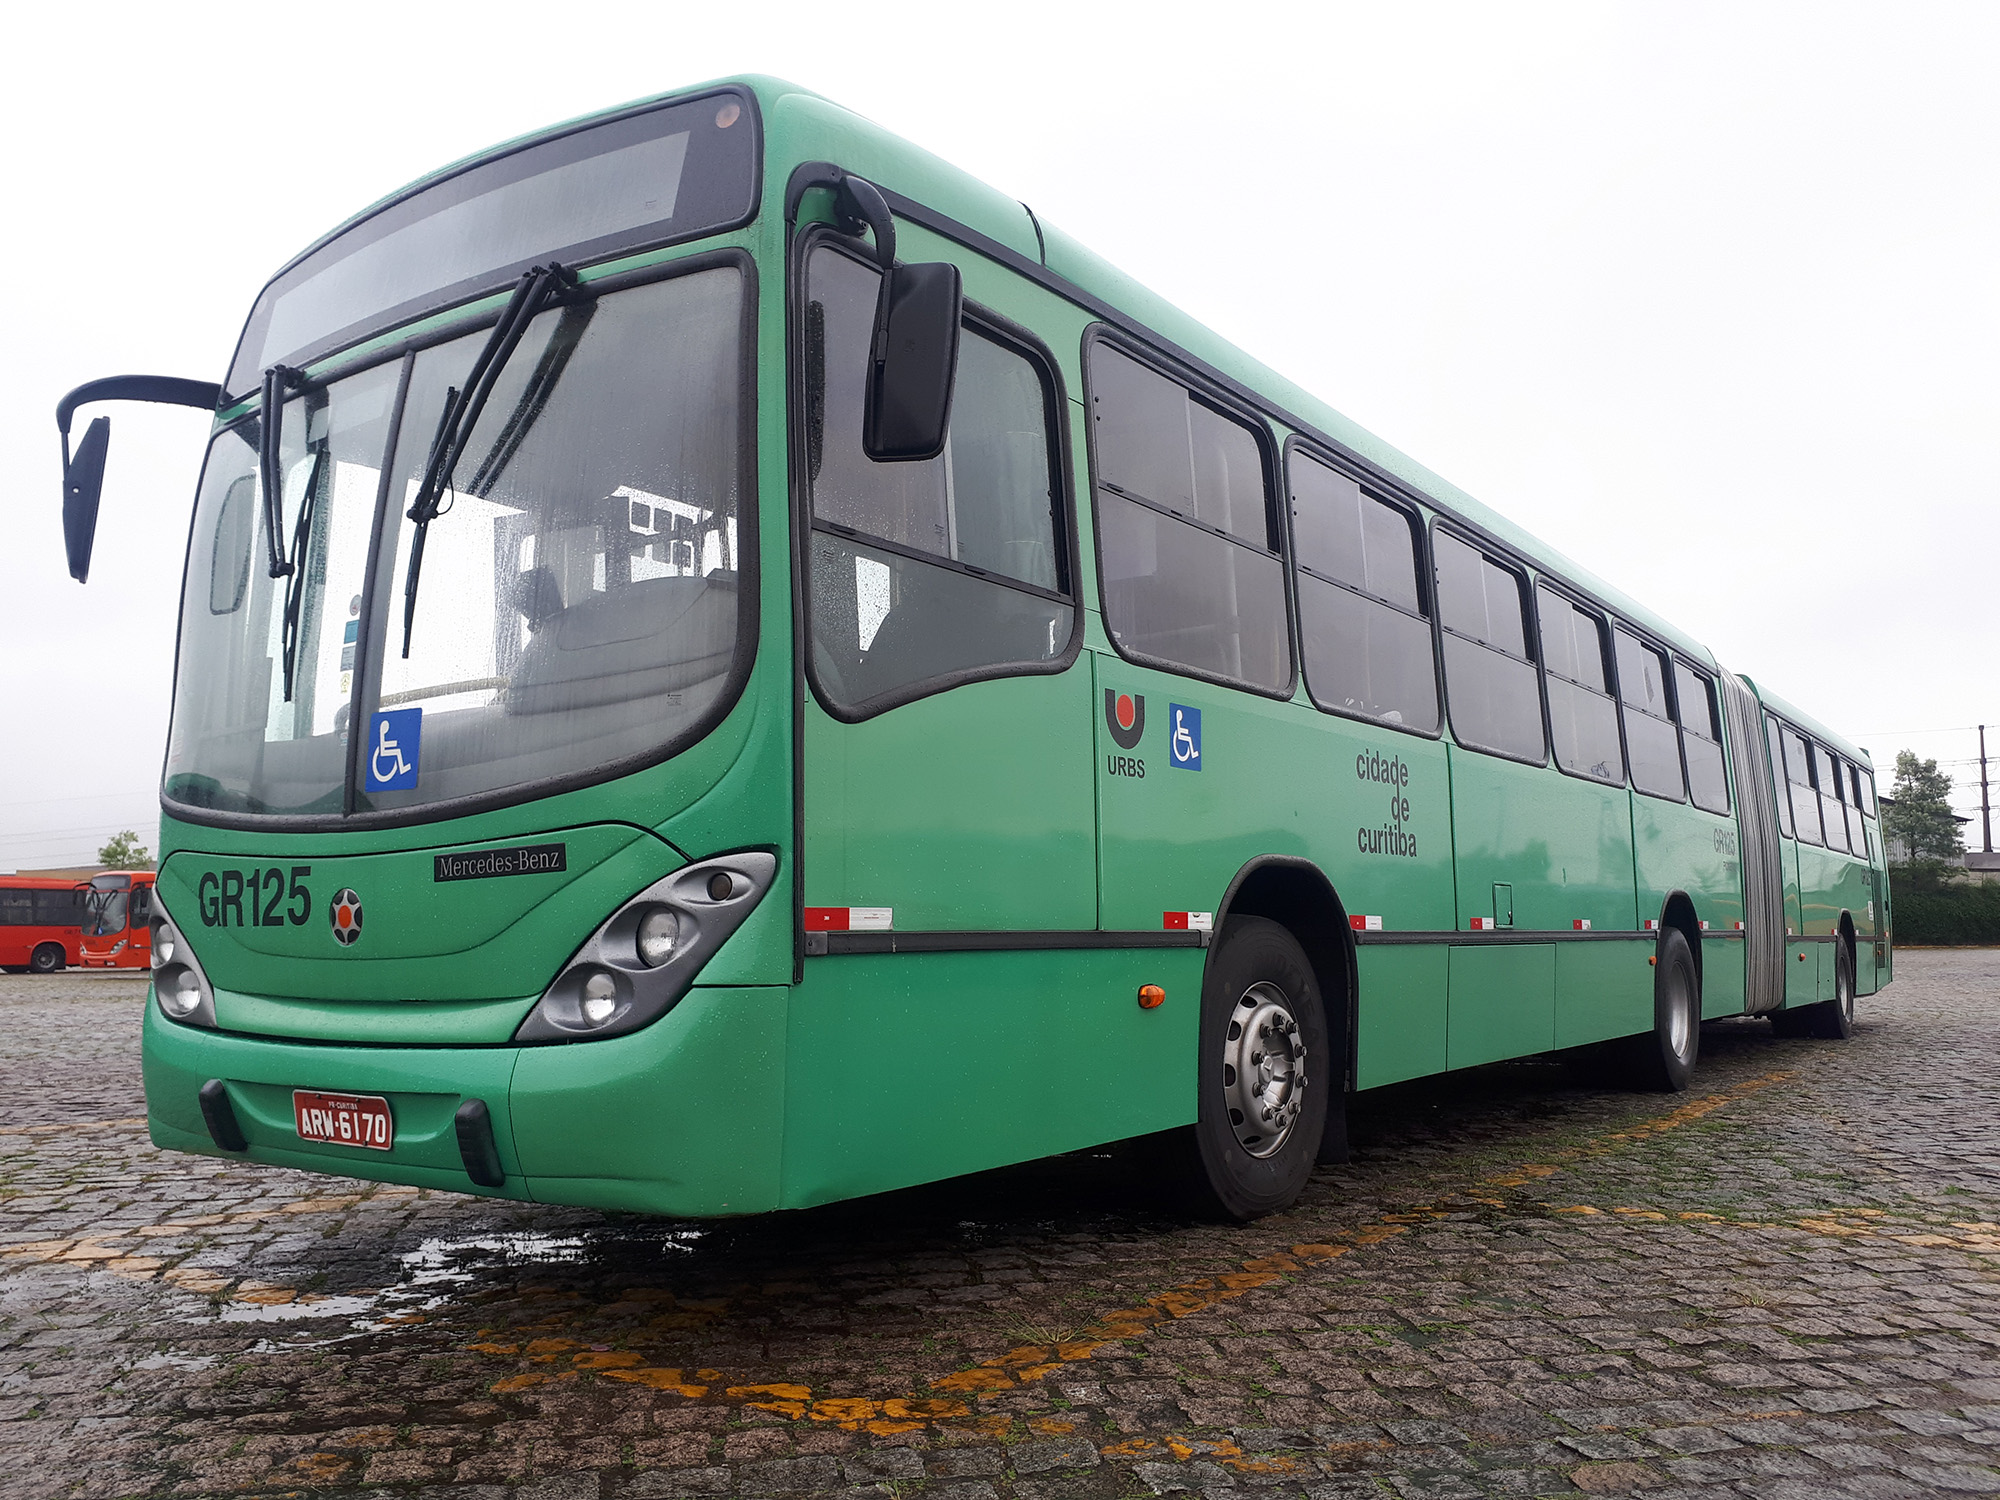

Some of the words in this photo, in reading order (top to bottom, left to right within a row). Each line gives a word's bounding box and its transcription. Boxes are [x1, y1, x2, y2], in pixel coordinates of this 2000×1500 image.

[1107, 755, 1145, 779] URBS
[1356, 748, 1408, 787] cidade
[1391, 789, 1410, 822] de
[1357, 822, 1417, 857] curitiba
[439, 849, 560, 878] Mercedes-Benz
[199, 866, 312, 927] GR125
